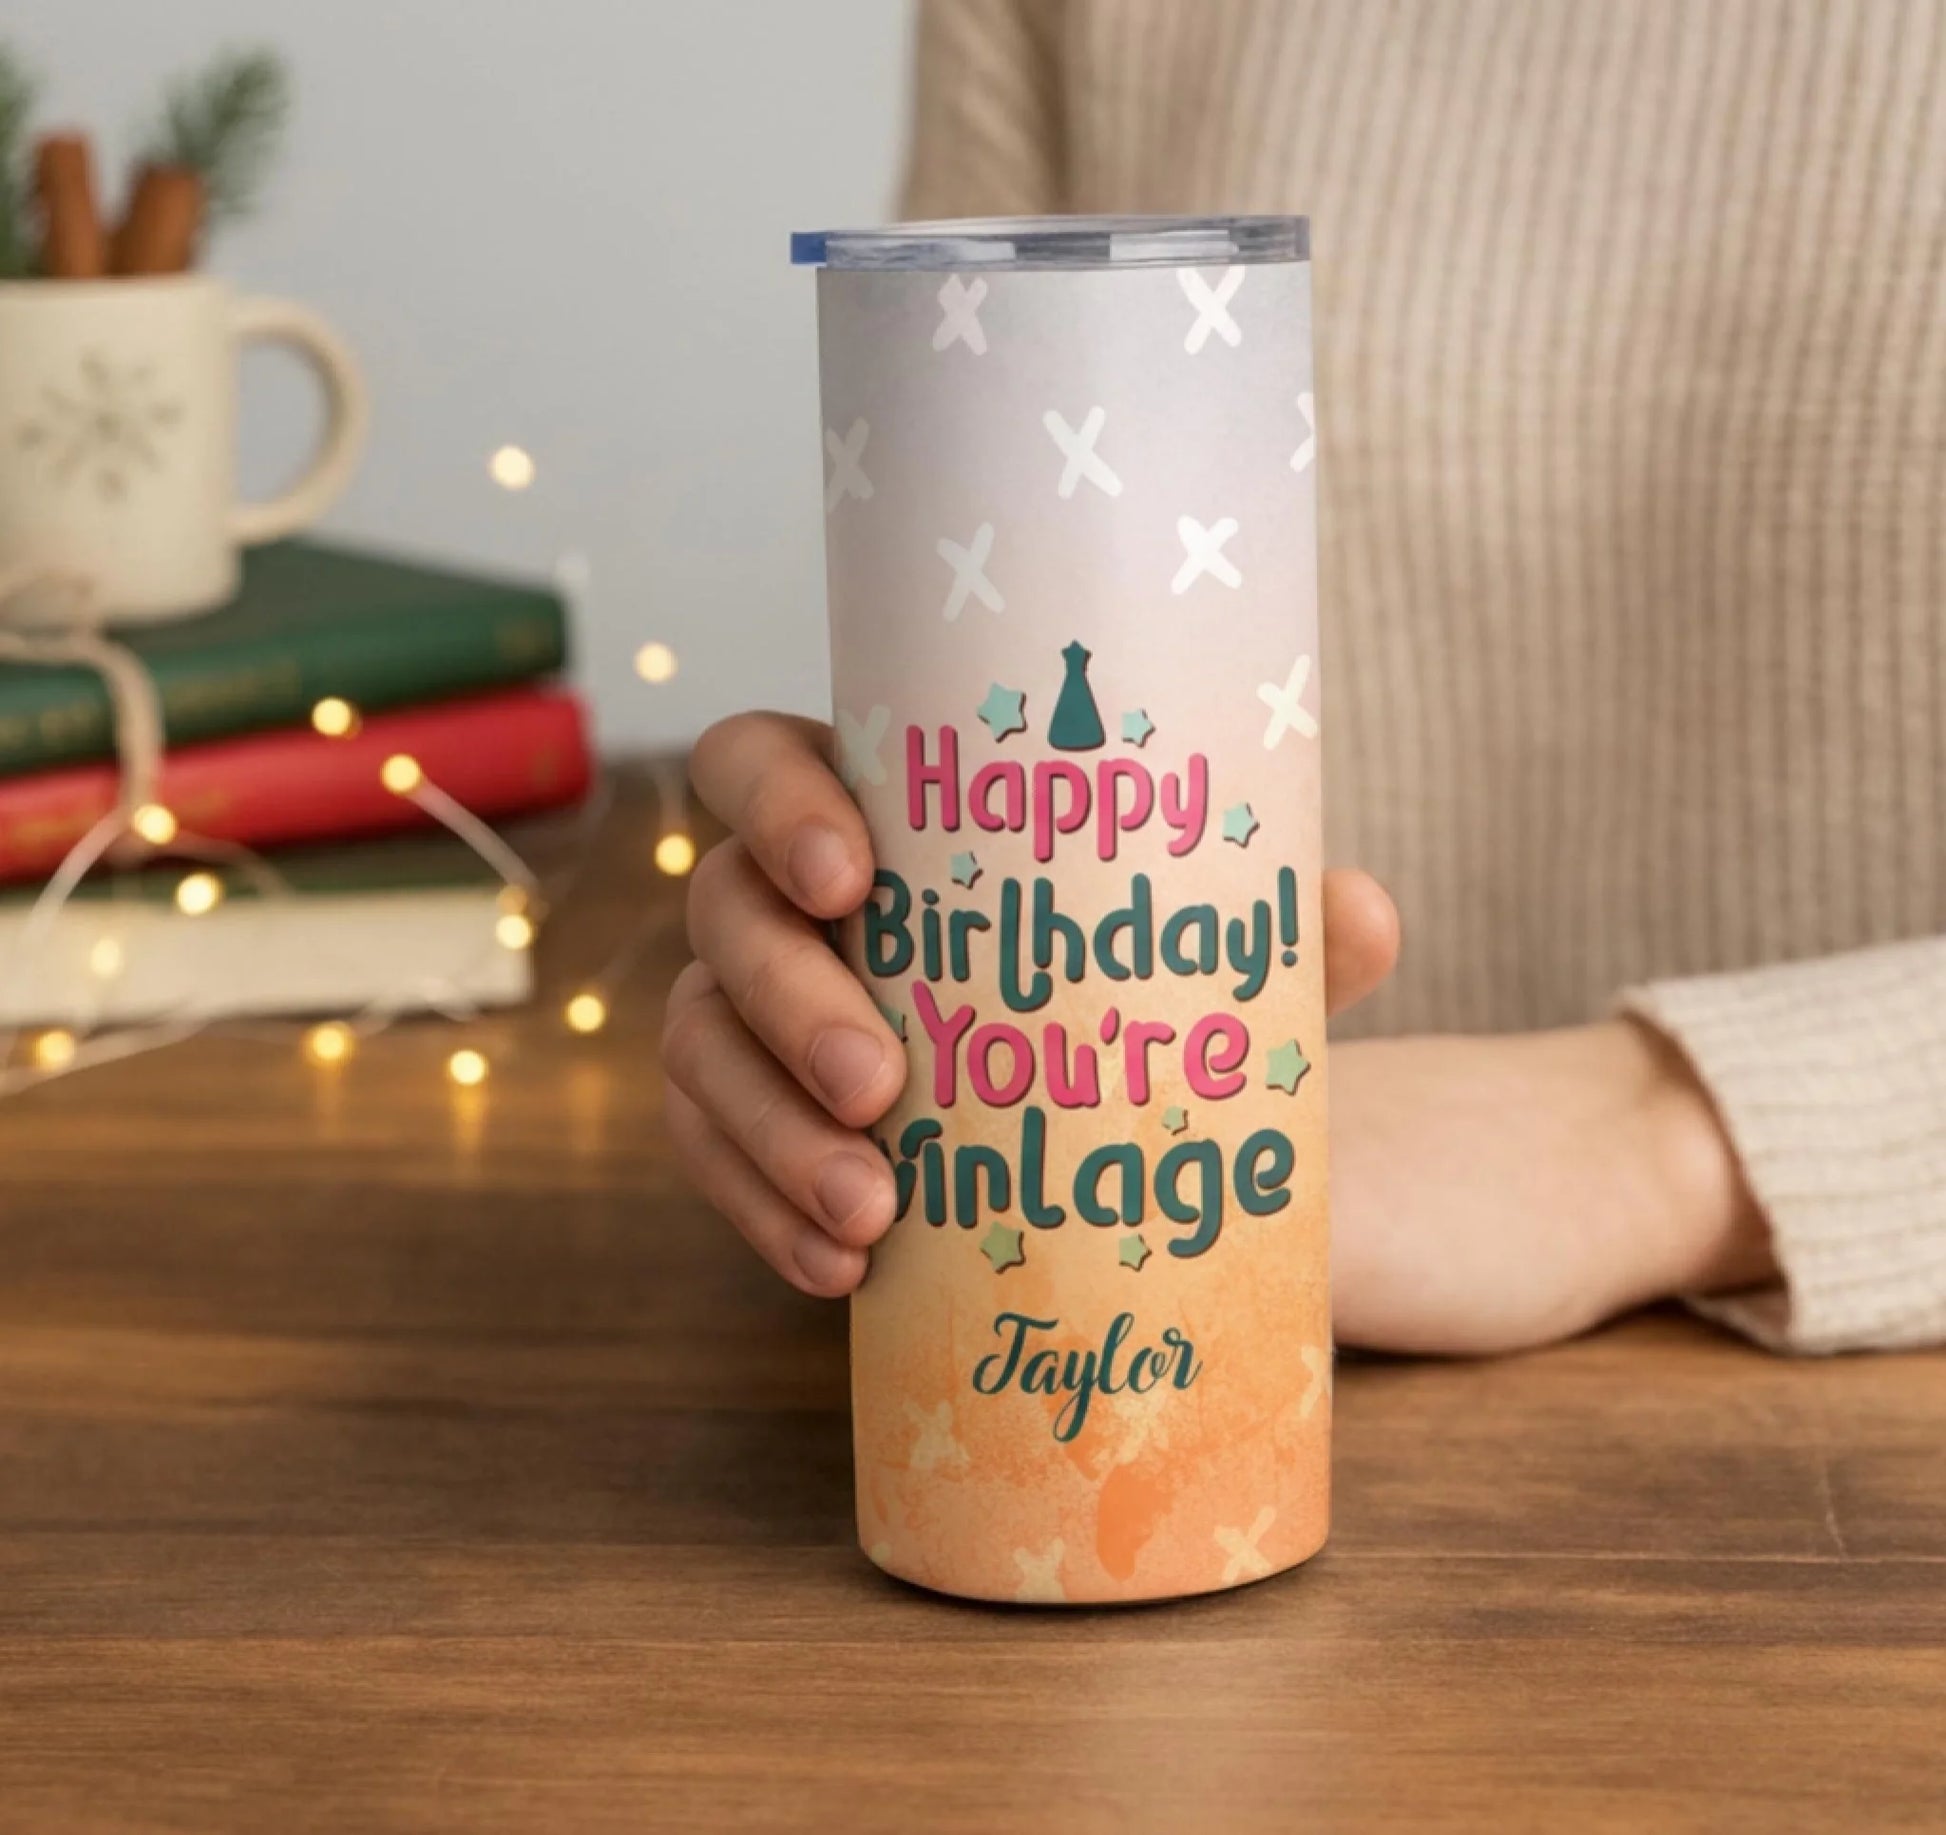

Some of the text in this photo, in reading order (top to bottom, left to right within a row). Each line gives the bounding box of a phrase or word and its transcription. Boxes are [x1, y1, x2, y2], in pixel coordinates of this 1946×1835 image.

[907, 725, 1208, 862] Happy
[913, 982, 1250, 1108] You're
[972, 1312, 1202, 1442] Taylor
